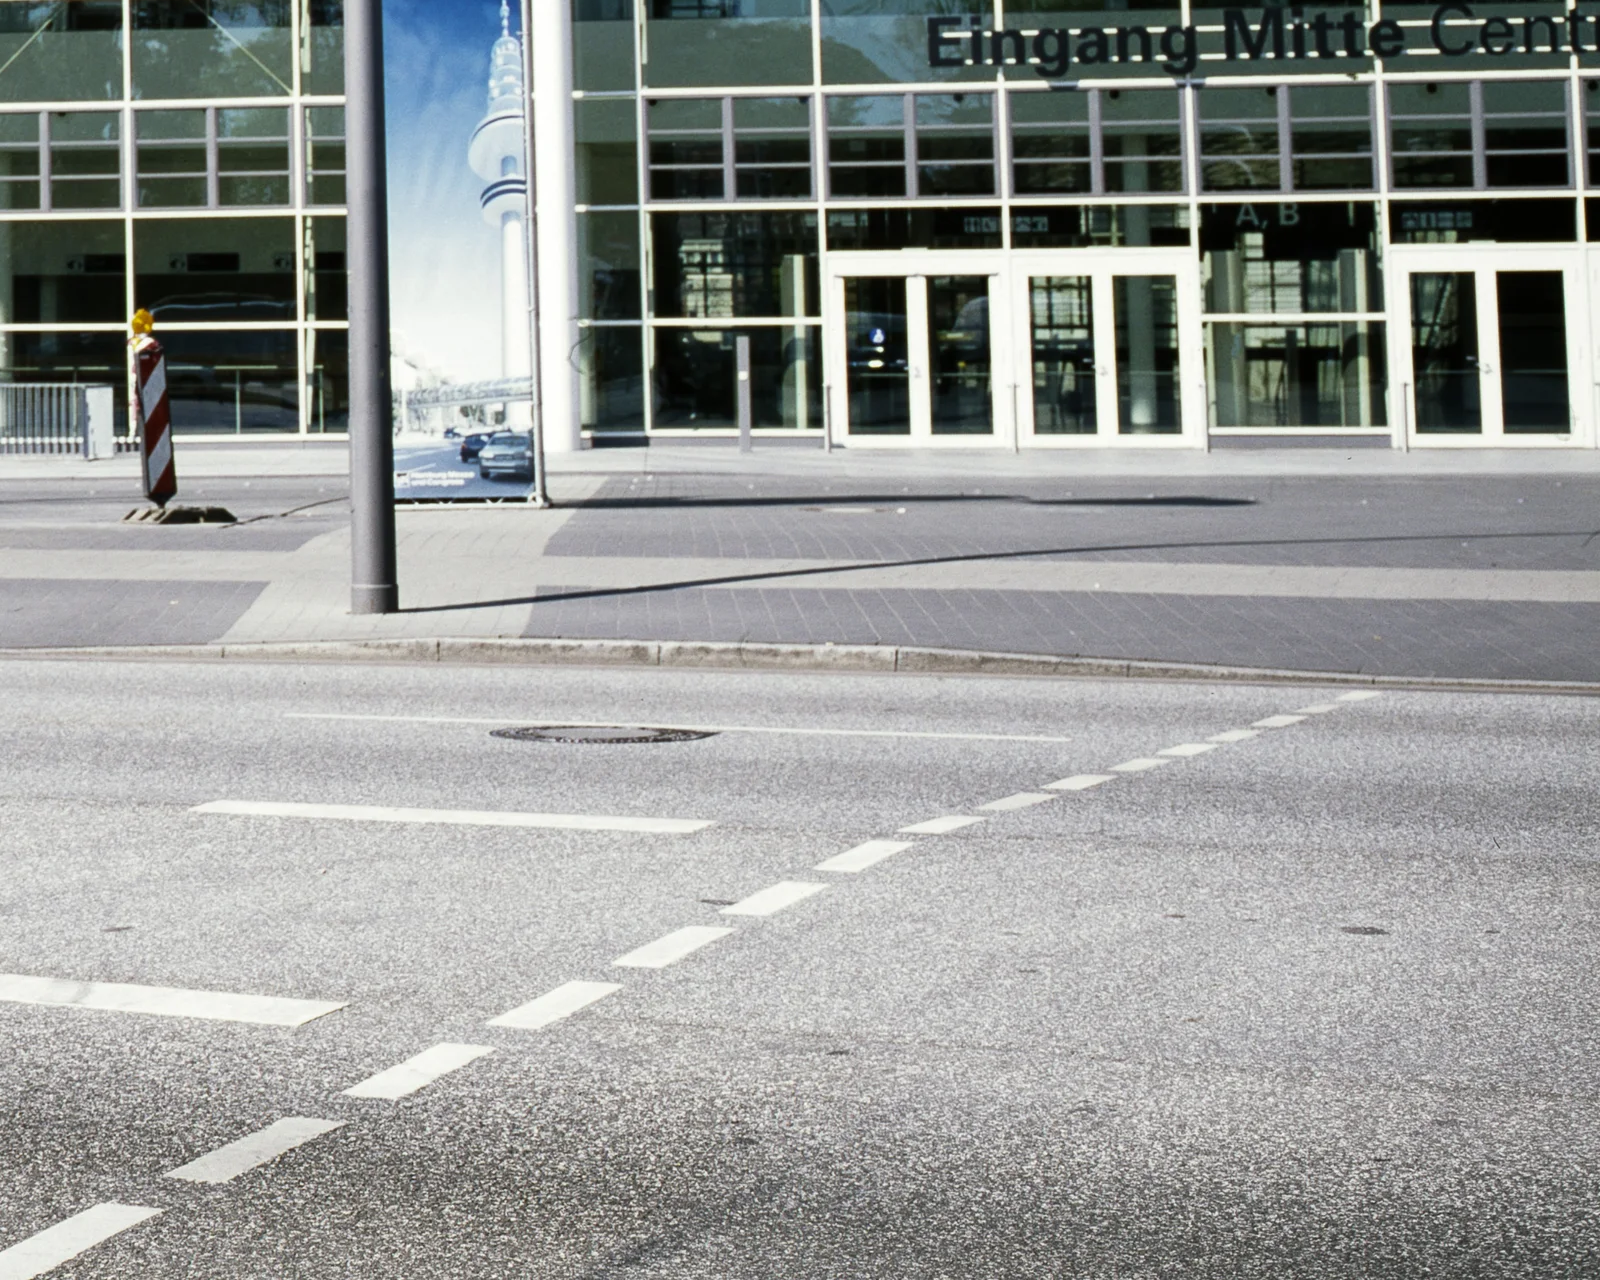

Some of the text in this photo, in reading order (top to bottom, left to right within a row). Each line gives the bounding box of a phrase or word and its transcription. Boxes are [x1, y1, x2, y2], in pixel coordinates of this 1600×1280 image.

[926, 2, 1600, 78] Eingang Mitte Cent
[1235, 202, 1301, 230] A, B
